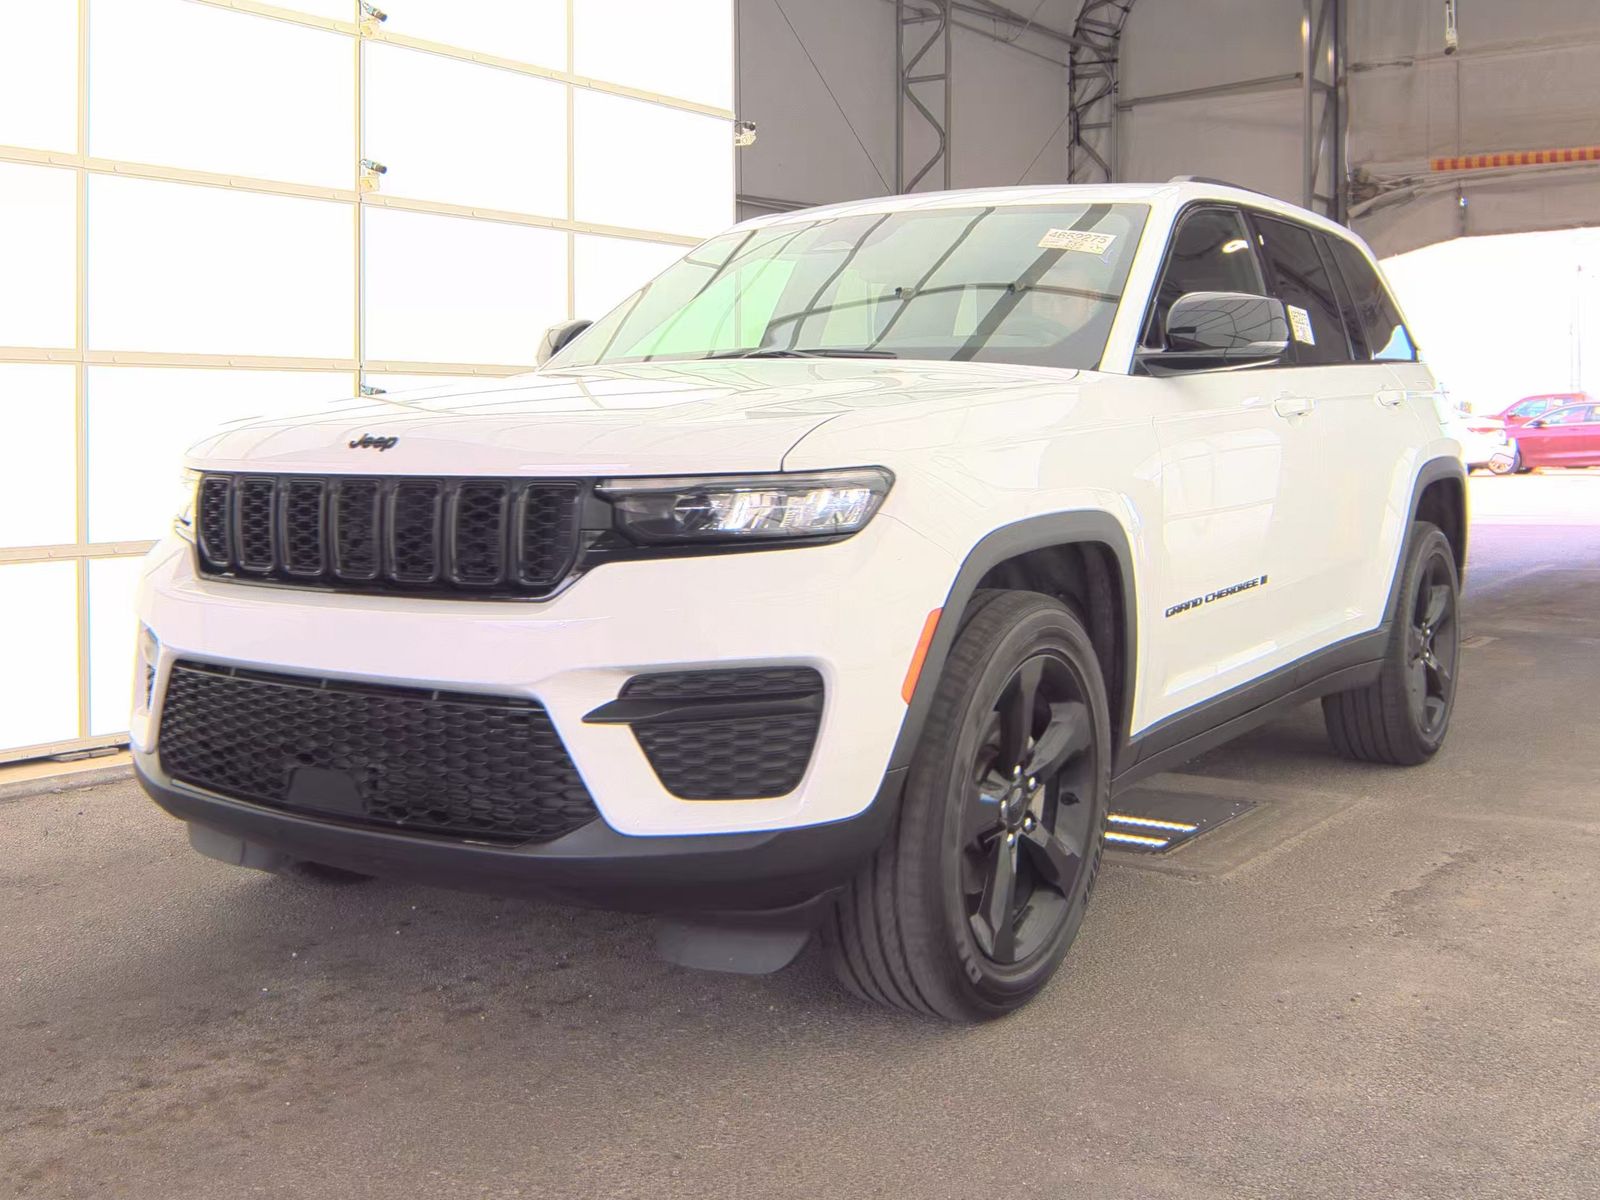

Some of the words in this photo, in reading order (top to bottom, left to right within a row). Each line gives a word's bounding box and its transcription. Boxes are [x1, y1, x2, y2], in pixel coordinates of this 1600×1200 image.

[349, 433, 398, 452] Jeep
[1165, 596, 1203, 618] GRAND
[1204, 577, 1259, 603] CHEROKEE
